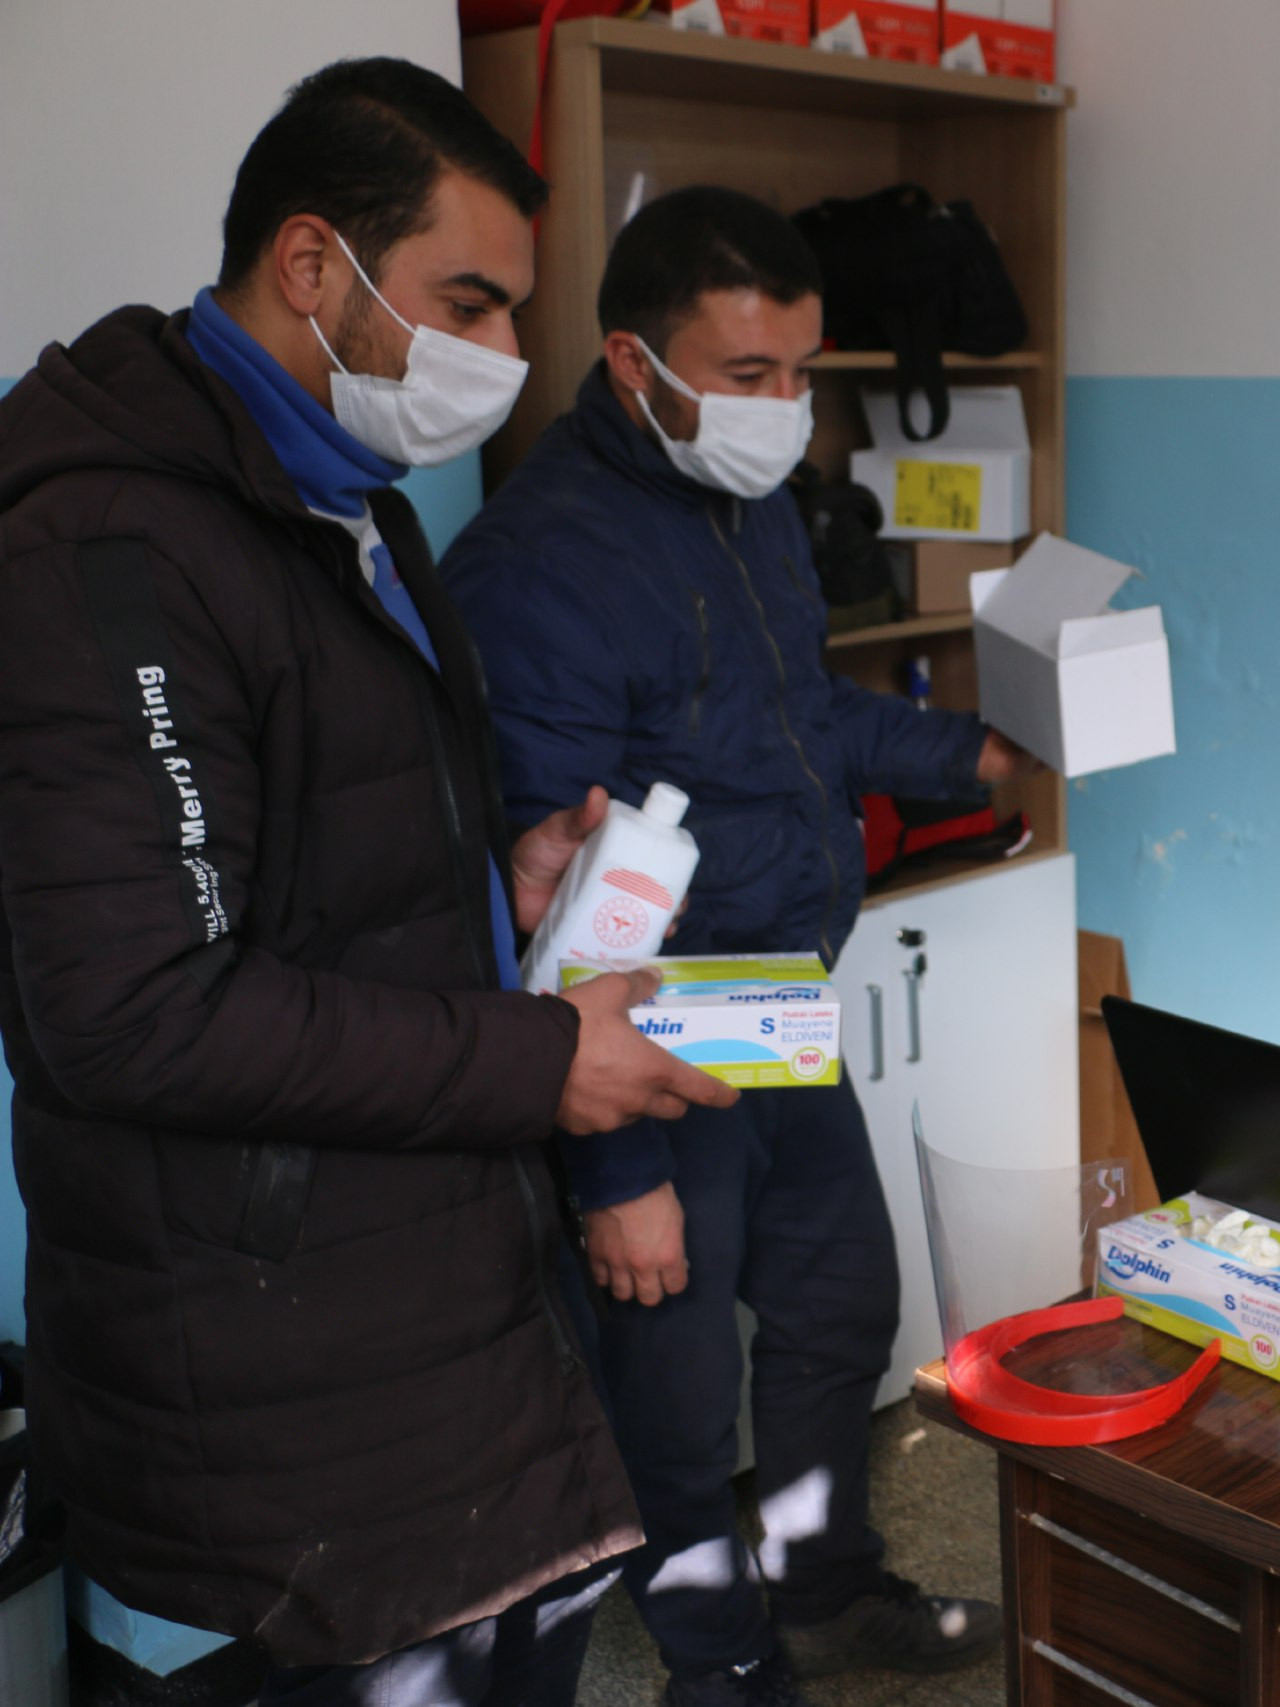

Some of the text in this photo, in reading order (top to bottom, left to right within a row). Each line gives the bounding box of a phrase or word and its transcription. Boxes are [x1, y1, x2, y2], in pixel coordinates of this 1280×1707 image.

[136, 665, 177, 749] Pring
[163, 757, 205, 847] Merry
[760, 1017, 775, 1034] S
[799, 1054, 820, 1065] 100
[1107, 1245, 1171, 1284] Dolphin
[1224, 1294, 1236, 1312] S
[1254, 1339, 1273, 1356] 100
